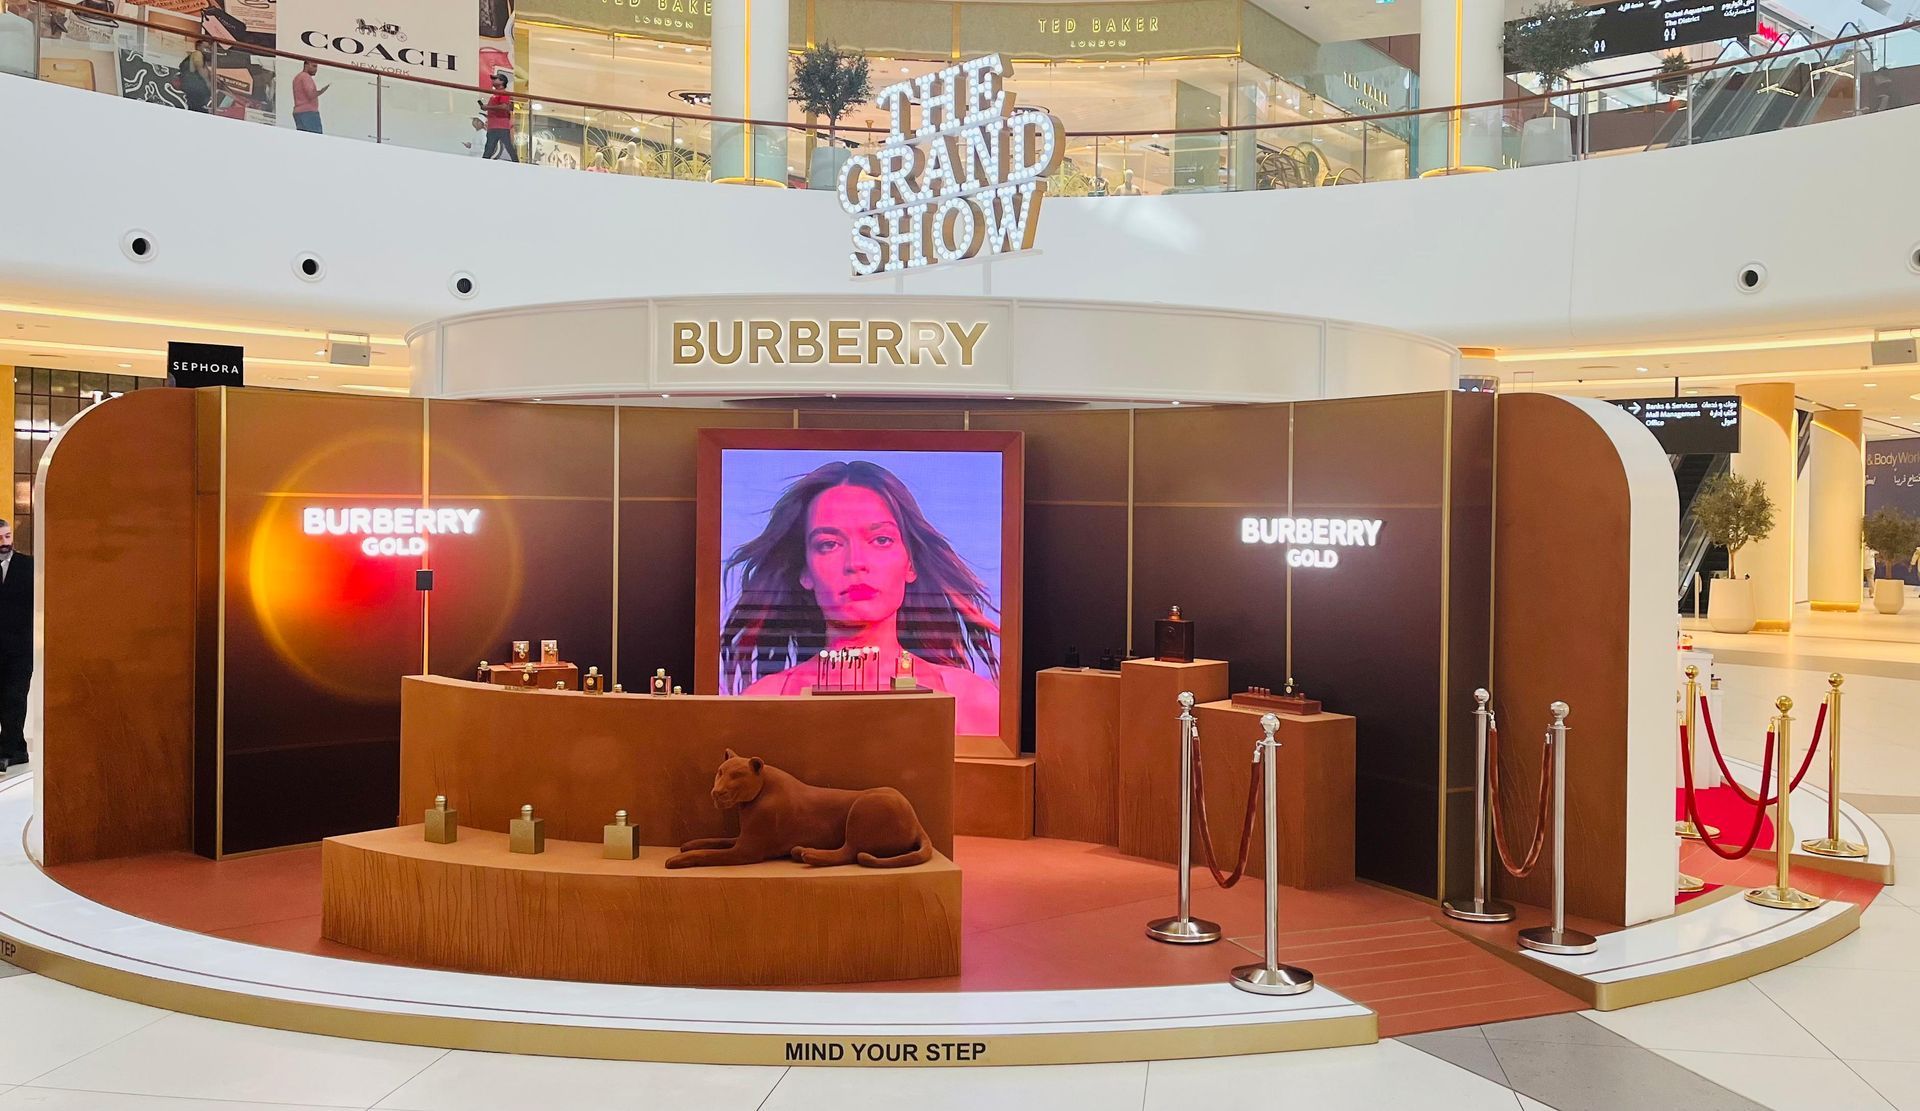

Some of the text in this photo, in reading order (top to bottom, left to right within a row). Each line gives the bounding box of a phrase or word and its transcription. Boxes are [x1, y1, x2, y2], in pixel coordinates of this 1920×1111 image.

[658, 0, 712, 16] BAKE
[1664, 4, 1714, 19] Dubai Aquarium
[634, 15, 694, 29] LONDON
[1038, 16, 1159, 33] TED BAKER
[1664, 15, 1701, 27] The District
[300, 30, 458, 71] COACH
[1070, 39, 1127, 48] LONDON
[876, 53, 1010, 146] THE
[837, 111, 1060, 214] GRAND
[850, 181, 1041, 276] SHOW
[672, 320, 989, 366] BURBERRY
[173, 361, 239, 374] SEPHORA
[1645, 402, 1665, 410] Banks
[1671, 401, 1698, 410] Services
[1660, 410, 1701, 419] Management
[1874, 452, 1898, 467] Body
[303, 507, 480, 535] BURBERRY
[1241, 517, 1383, 546] BURBERRY
[361, 536, 427, 556] GOLD
[1286, 548, 1339, 568] GOLD
[0, 939, 17, 958] TEP
[785, 1042, 987, 1061] MIND YOUR STEP
